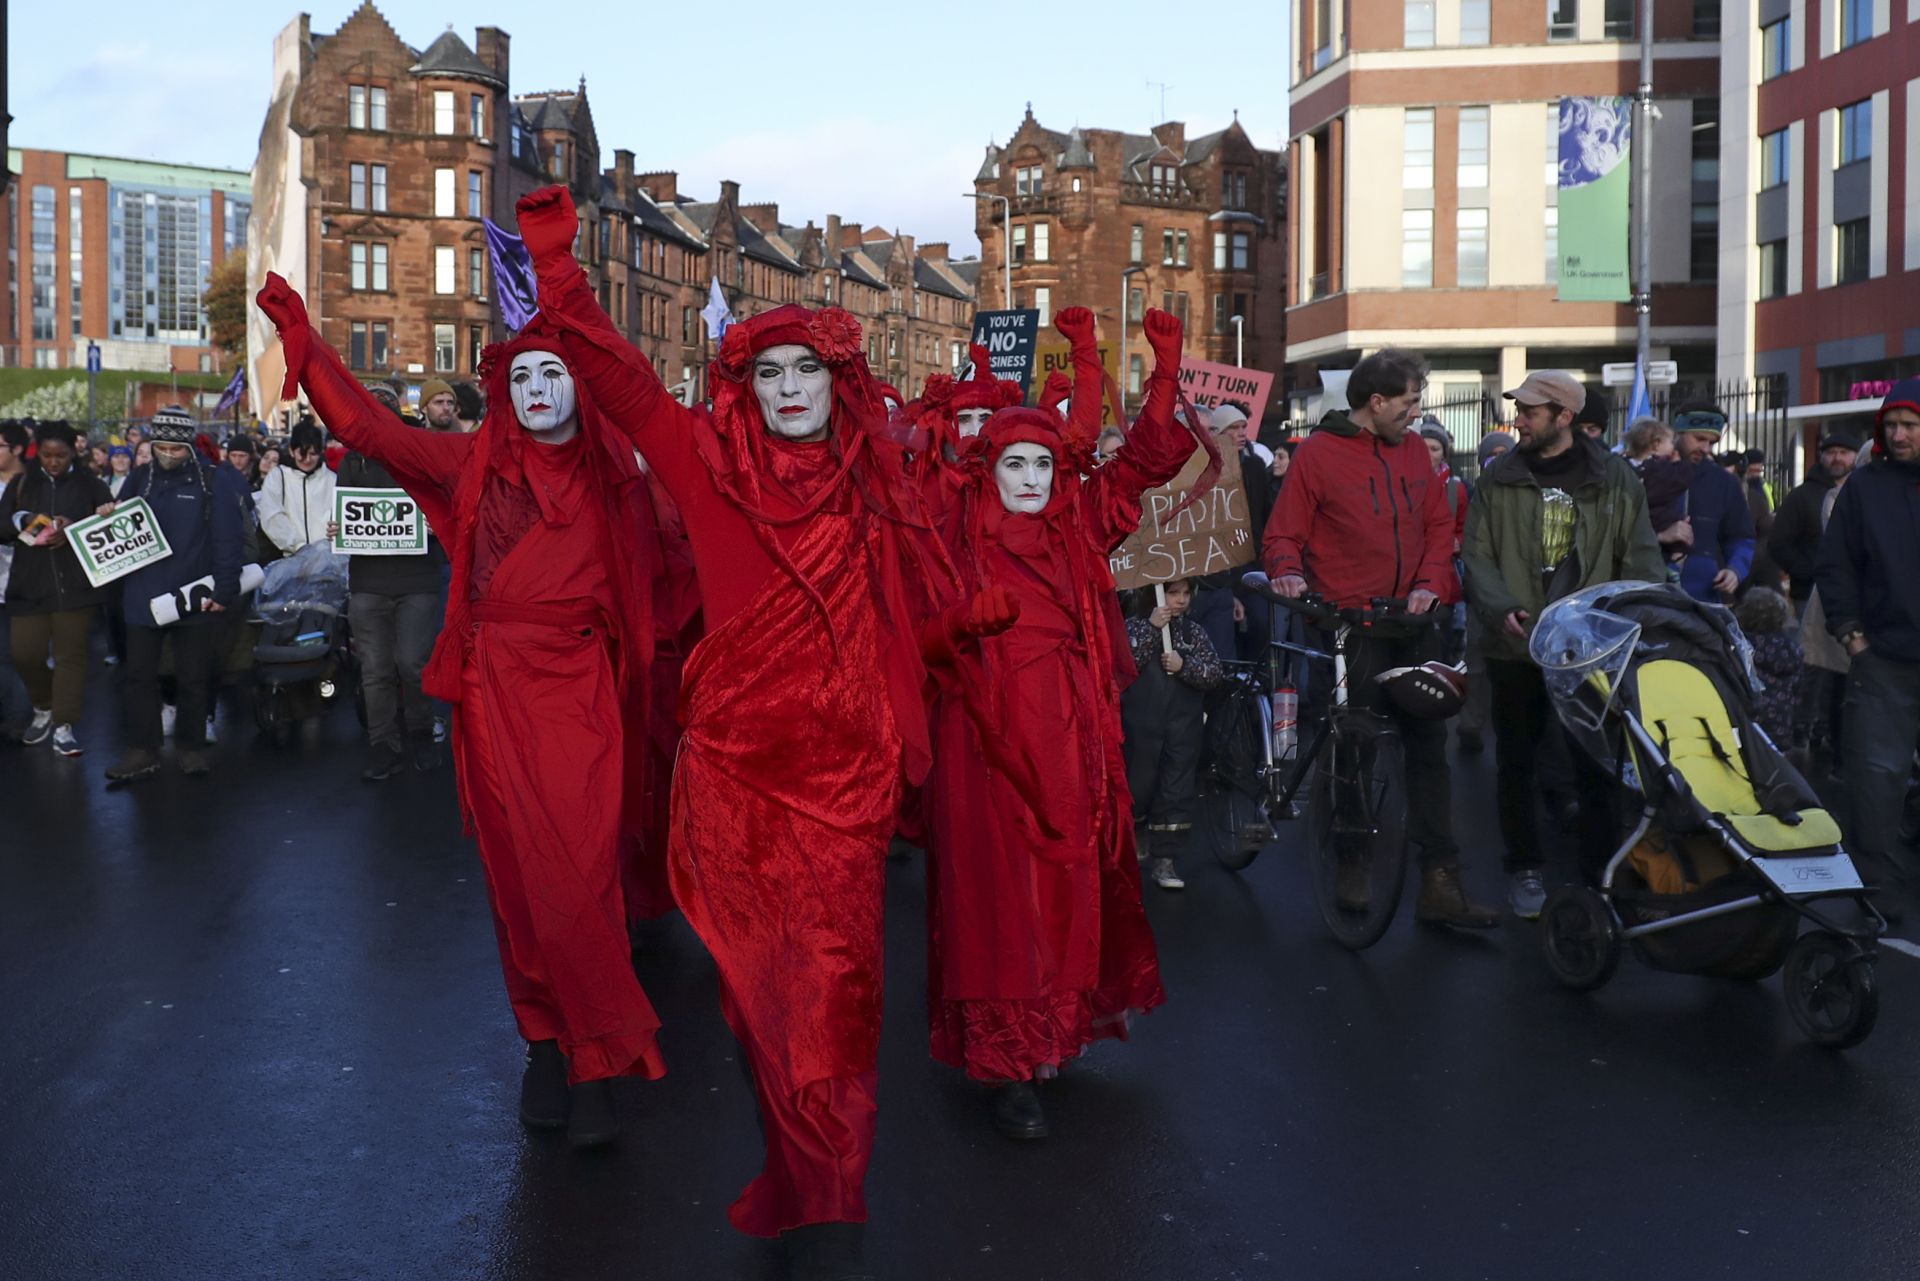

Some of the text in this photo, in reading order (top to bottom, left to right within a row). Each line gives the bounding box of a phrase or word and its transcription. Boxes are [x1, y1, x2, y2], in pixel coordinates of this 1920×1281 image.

[989, 315, 1026, 327] YOU'VE
[989, 355, 1026, 368] SINESS
[1217, 375, 1258, 397] TURN
[345, 524, 414, 536] ECOCIDE
[94, 531, 154, 564] ECOCIDE
[343, 539, 417, 550] change the law
[1109, 536, 1229, 580] THE SEA
